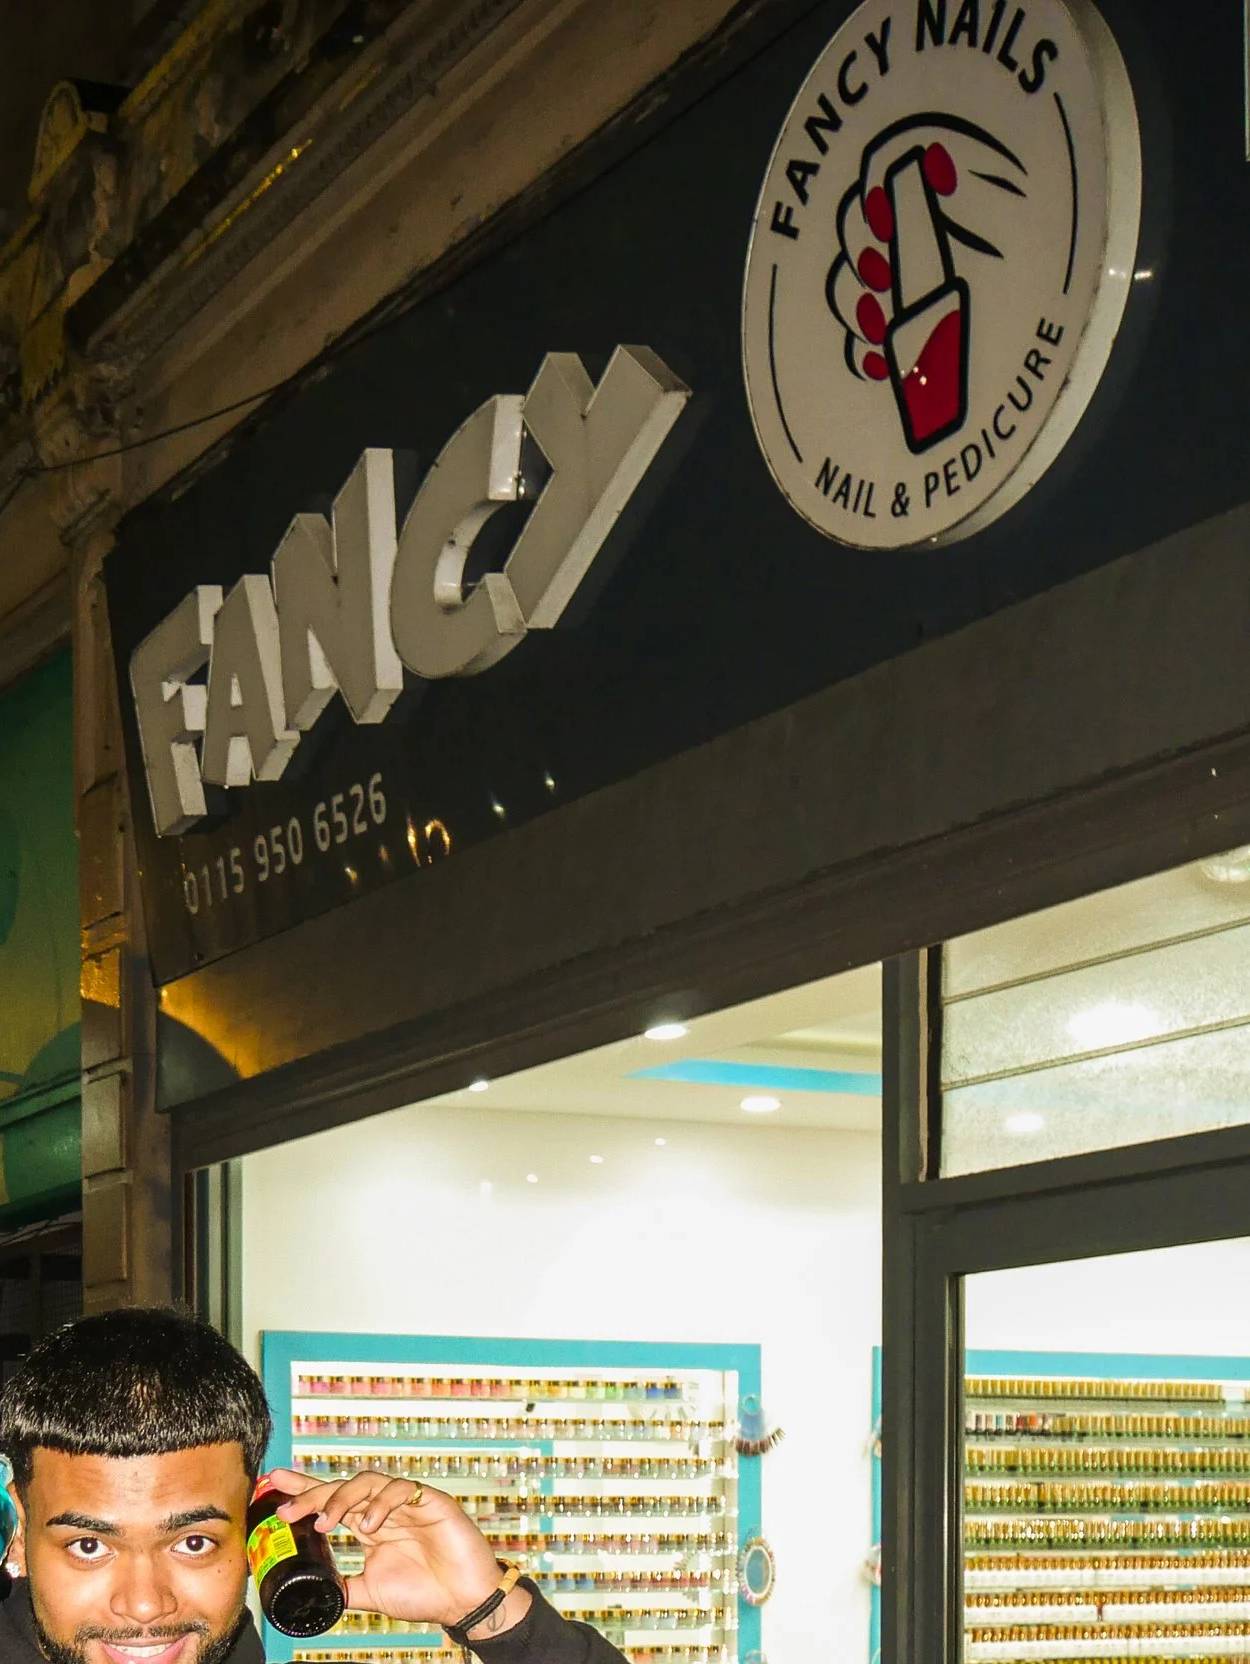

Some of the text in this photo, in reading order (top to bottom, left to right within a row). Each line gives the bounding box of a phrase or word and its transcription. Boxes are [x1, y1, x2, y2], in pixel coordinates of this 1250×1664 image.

[771, 0, 1059, 240] FANCY NAILS
[815, 317, 1064, 518] NAIL & PEDICURE
[130, 344, 692, 838] FANCY
[184, 772, 387, 914] 0115 950 6526
